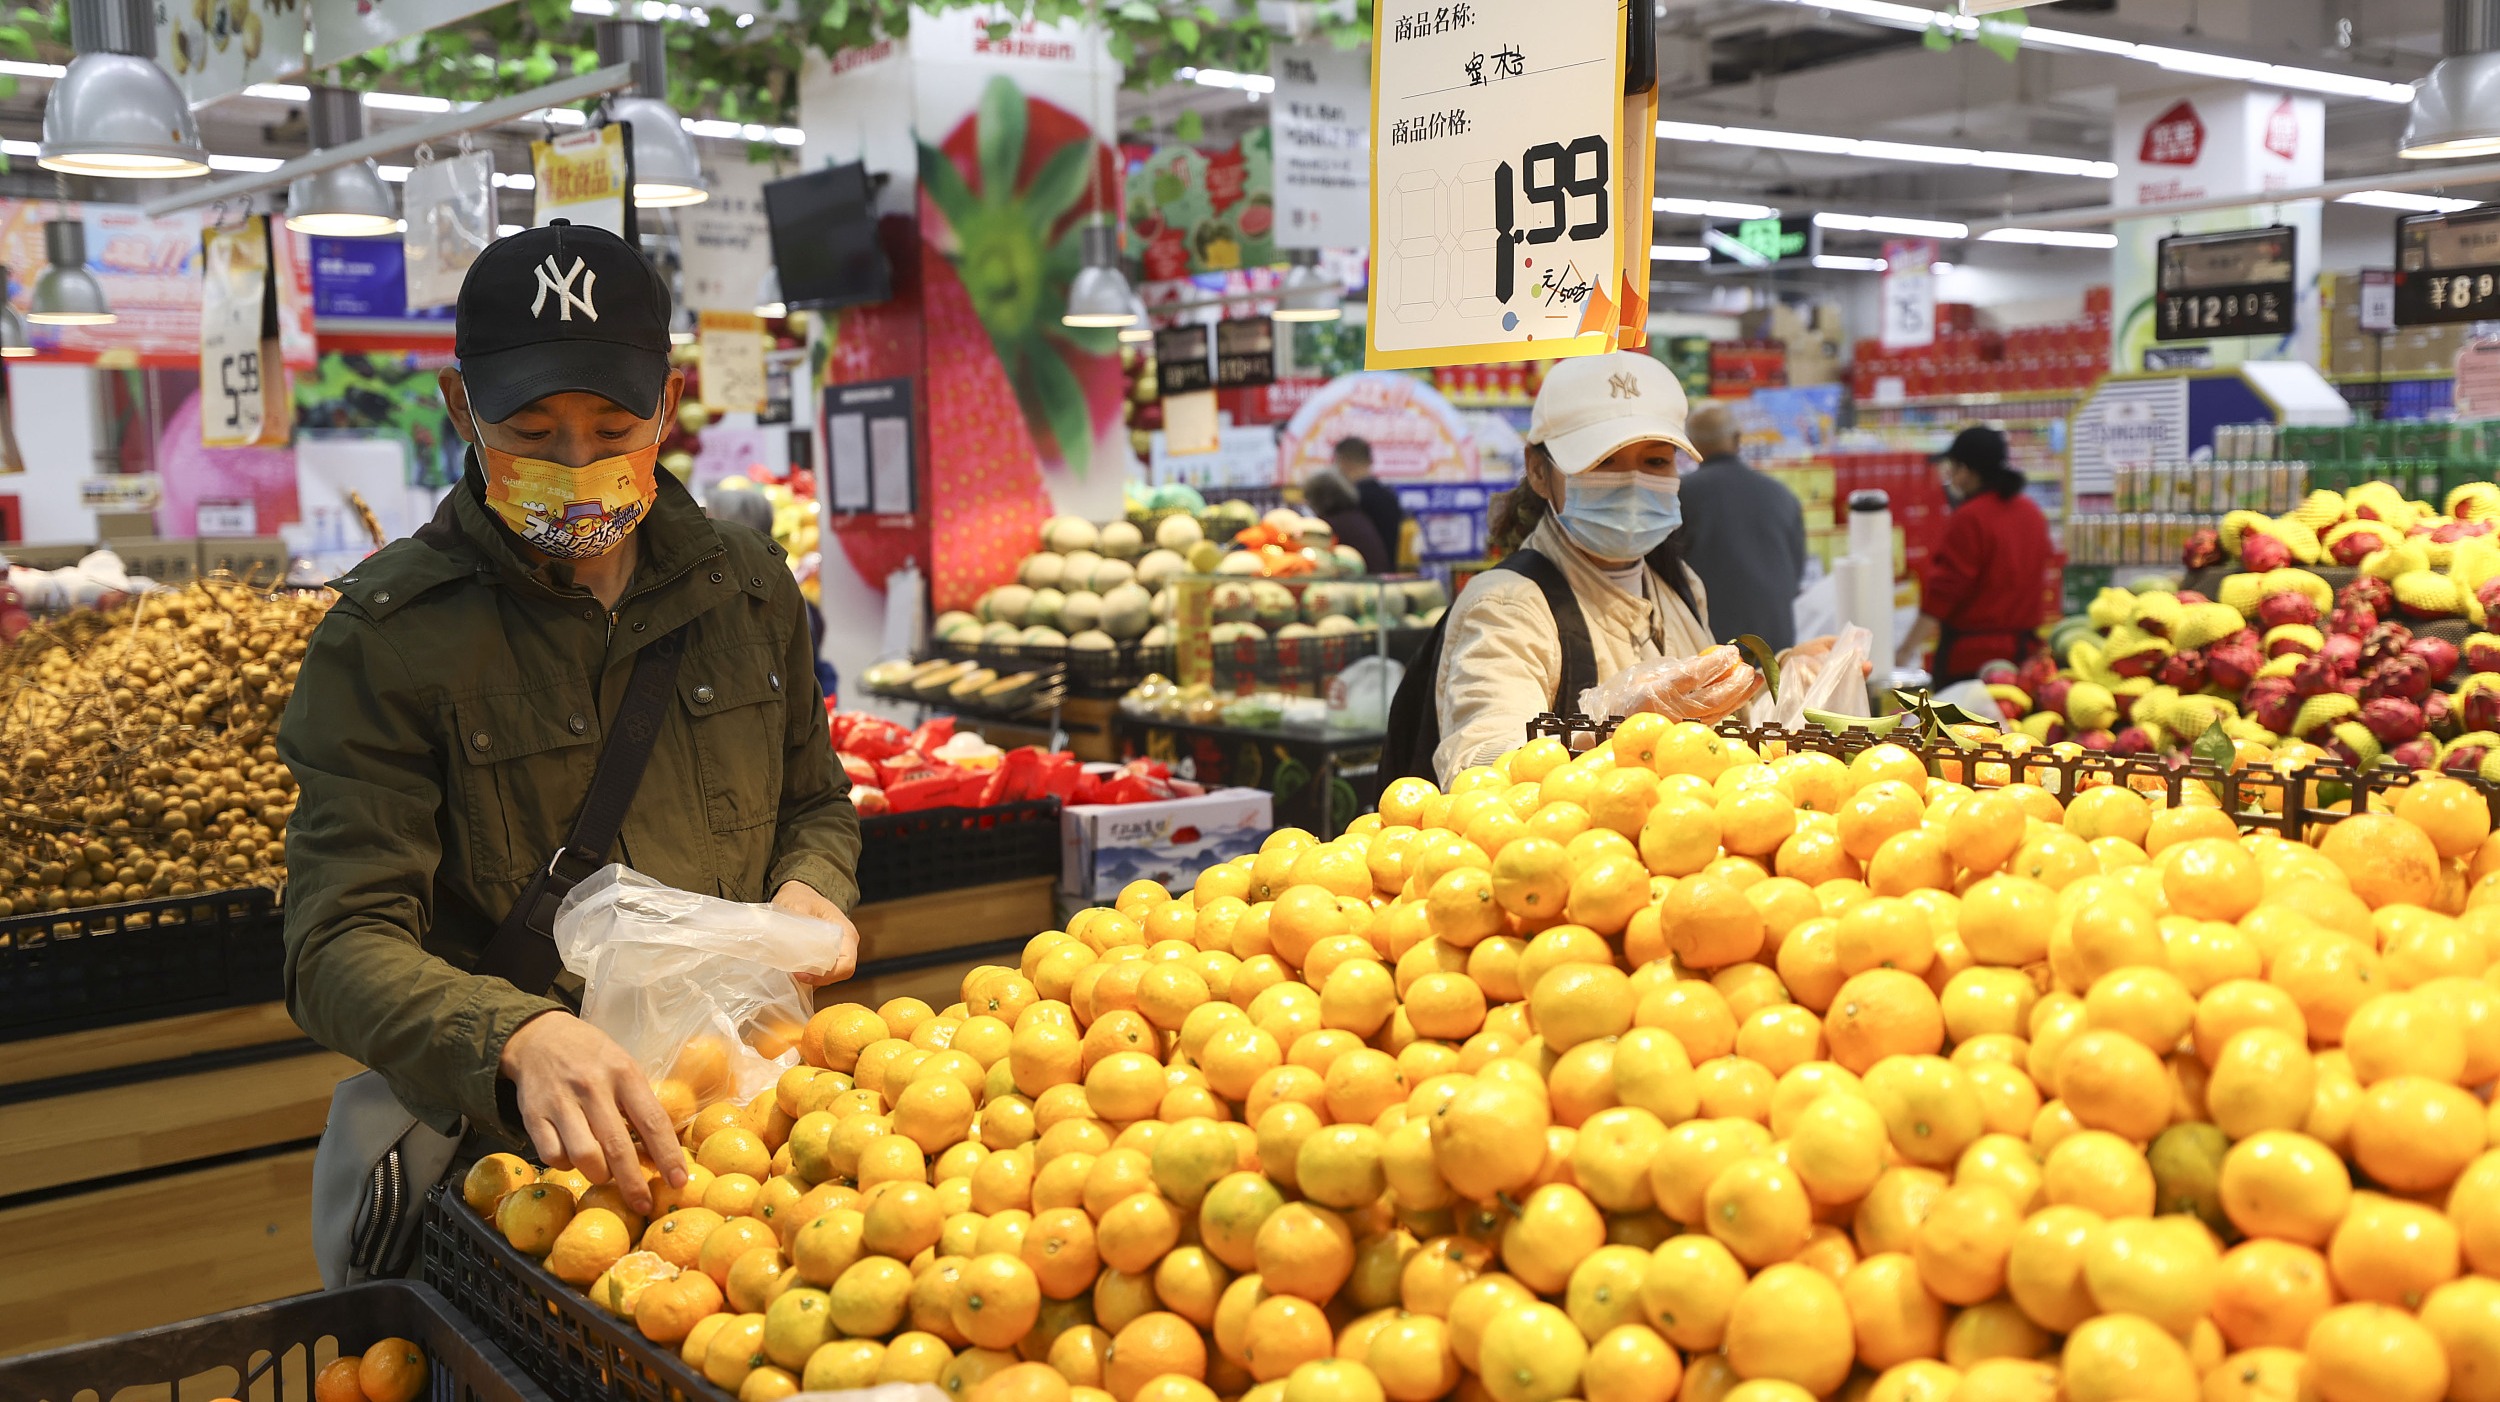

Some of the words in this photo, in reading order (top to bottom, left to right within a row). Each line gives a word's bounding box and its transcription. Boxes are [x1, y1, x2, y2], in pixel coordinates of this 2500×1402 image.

[1395, 3, 1475, 43] 商品名称:
[1464, 43, 1526, 87] 蜜桔
[1392, 109, 1471, 146] 商品价格:
[1495, 135, 1609, 304] 1.99
[530, 254, 599, 322] NY
[1608, 372, 1641, 400] NY
